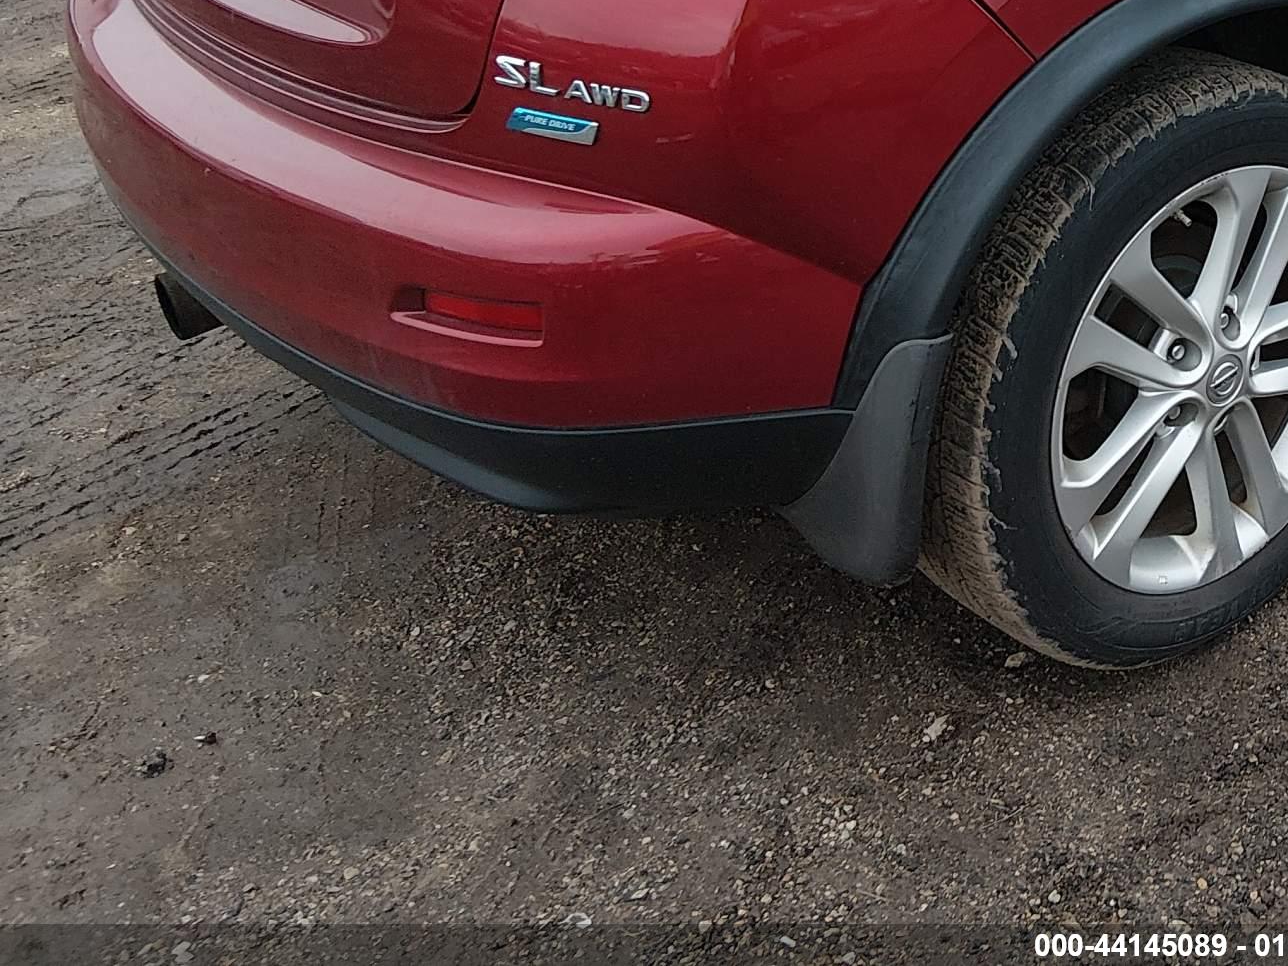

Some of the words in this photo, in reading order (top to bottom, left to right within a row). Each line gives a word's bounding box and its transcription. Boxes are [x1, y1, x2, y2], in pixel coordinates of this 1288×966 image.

[494, 55, 560, 96] SL
[563, 80, 650, 112] AWD
[524, 114, 548, 126] PURE
[548, 117, 577, 131] DRIVE
